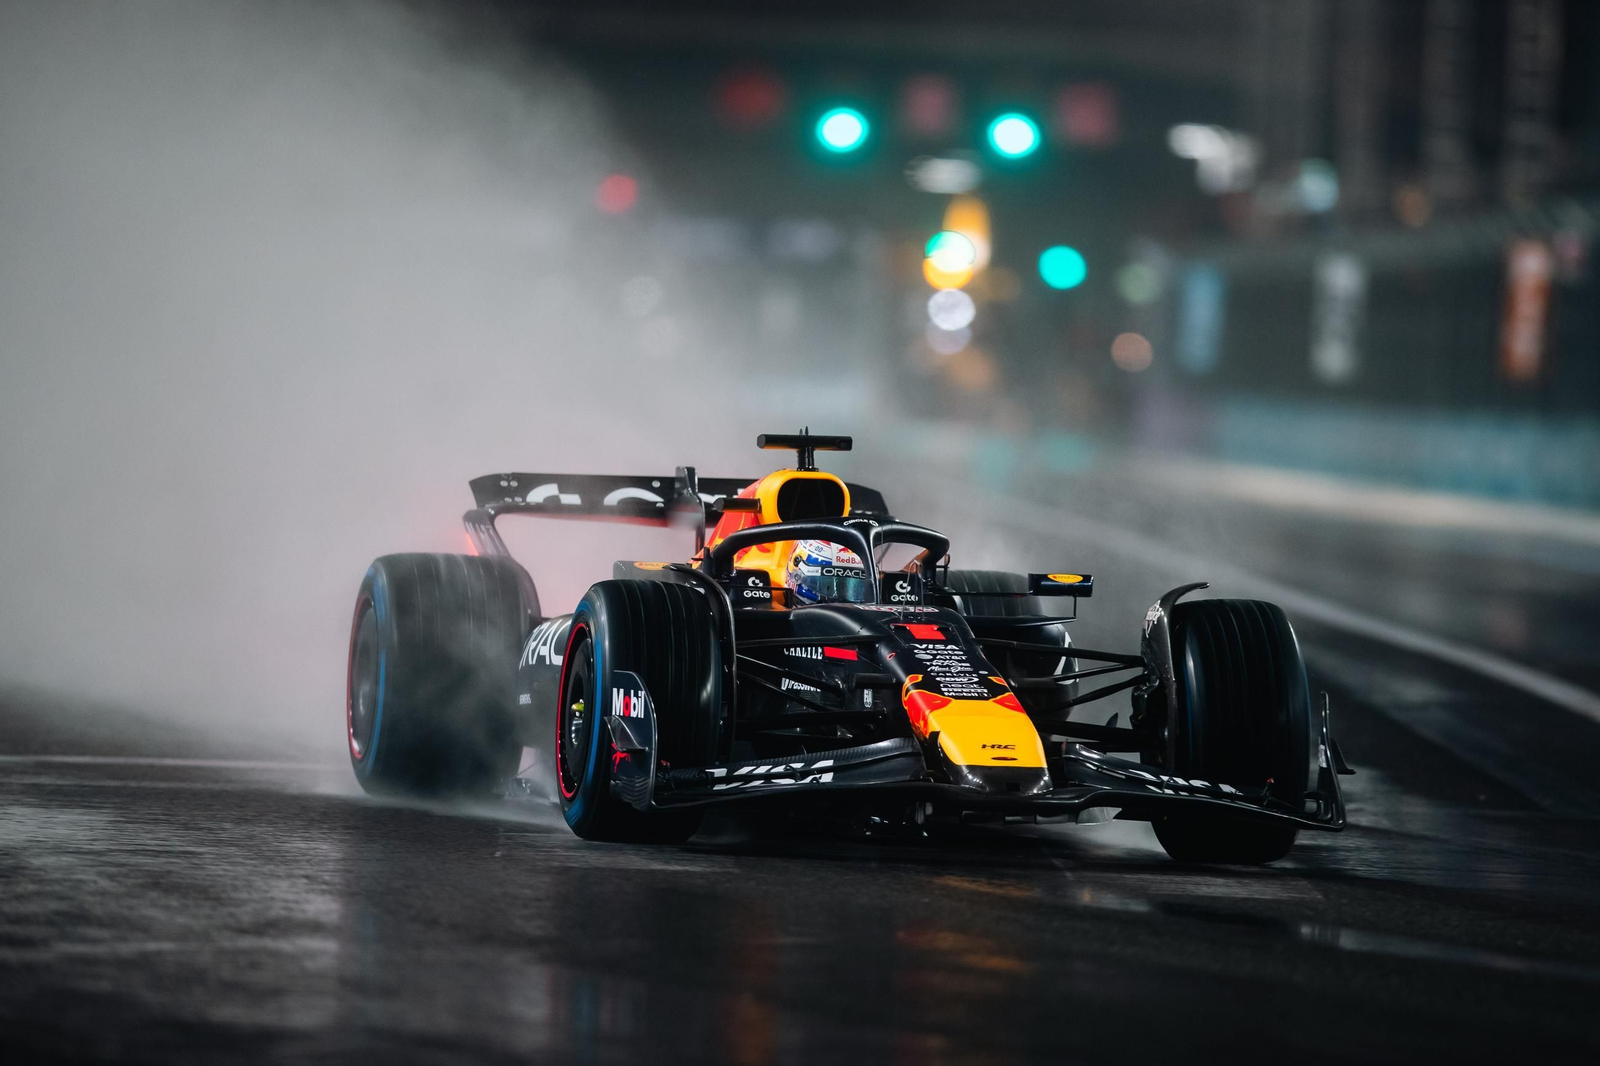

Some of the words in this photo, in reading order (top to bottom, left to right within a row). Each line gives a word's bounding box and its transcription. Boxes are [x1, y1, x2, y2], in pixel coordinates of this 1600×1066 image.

[836, 556, 850, 564] Red
[743, 588, 770, 599] Gate
[891, 593, 918, 602] Gate
[612, 687, 645, 718] Mobil
